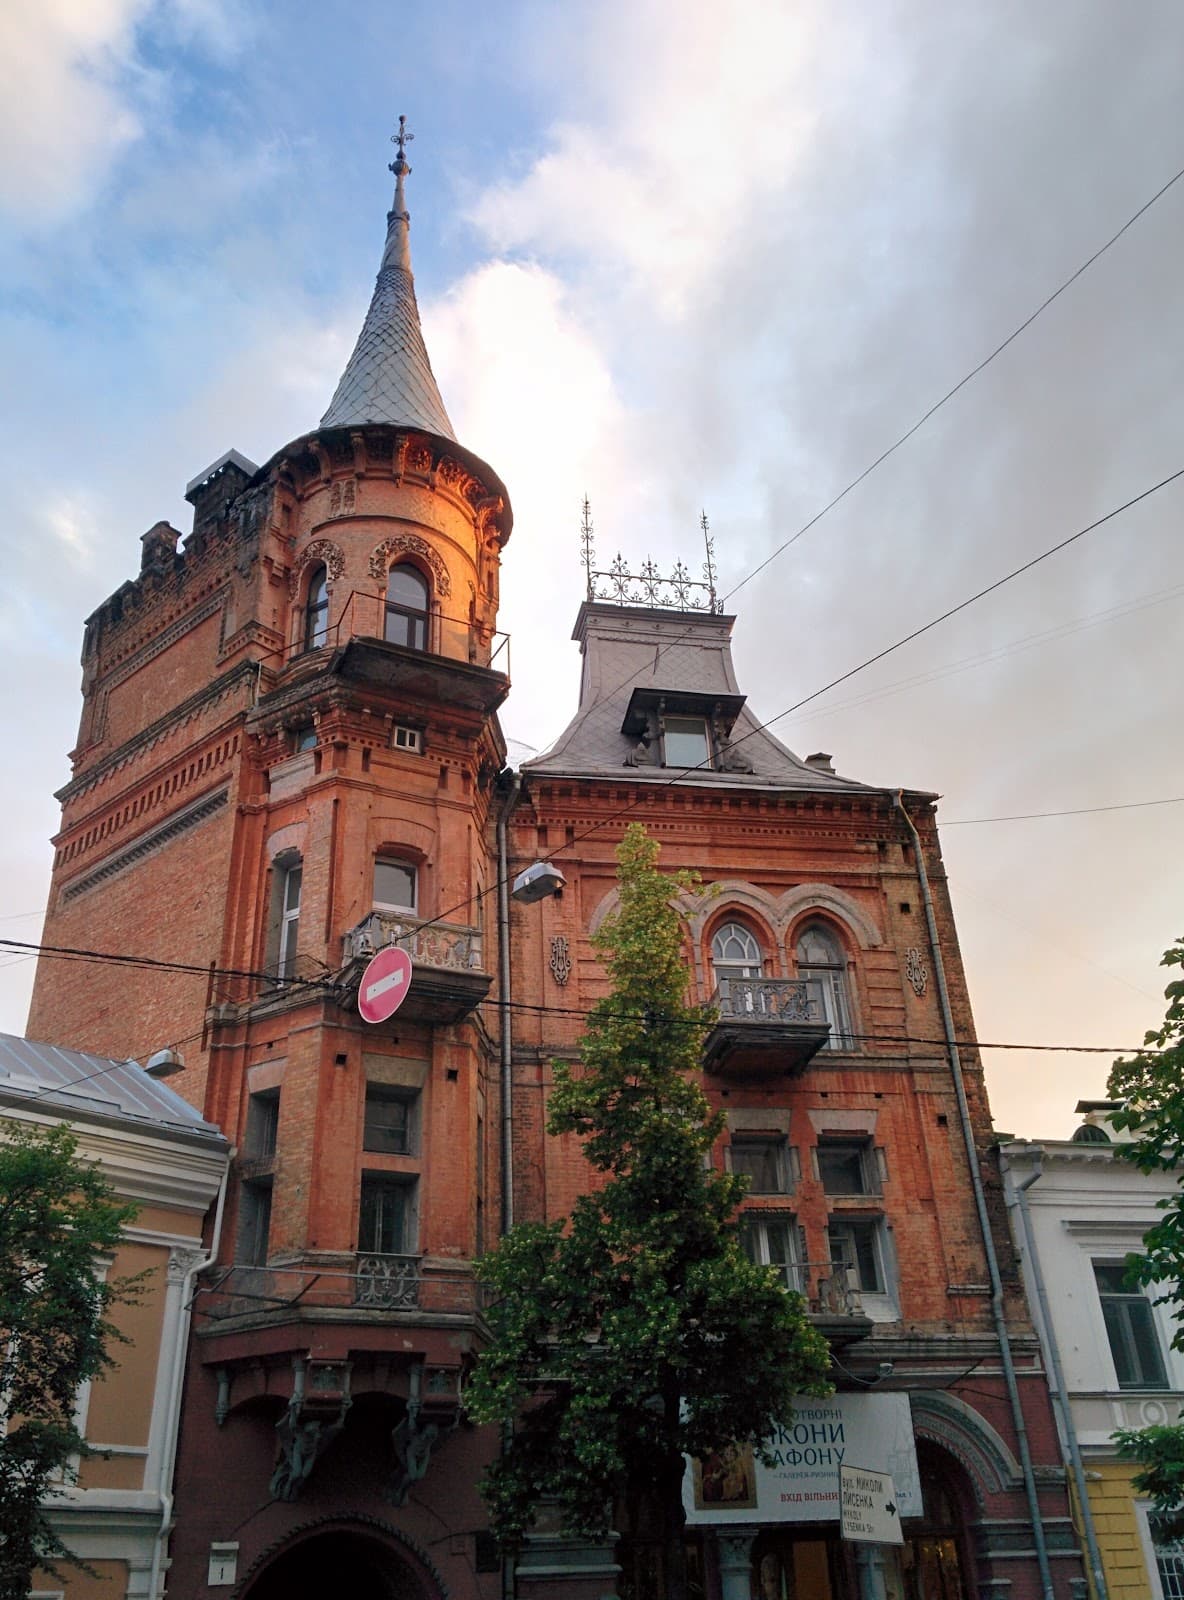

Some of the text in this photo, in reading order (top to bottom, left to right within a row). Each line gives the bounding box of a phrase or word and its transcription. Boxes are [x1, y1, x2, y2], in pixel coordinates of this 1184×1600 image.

[773, 1447, 845, 1466] АФОНУ
[856, 1476, 883, 1493] МИКОЛИ
[780, 1491, 839, 1502] ВХІД ВІЛЬНИ
[842, 1491, 874, 1509] ЛИСЕНКА
